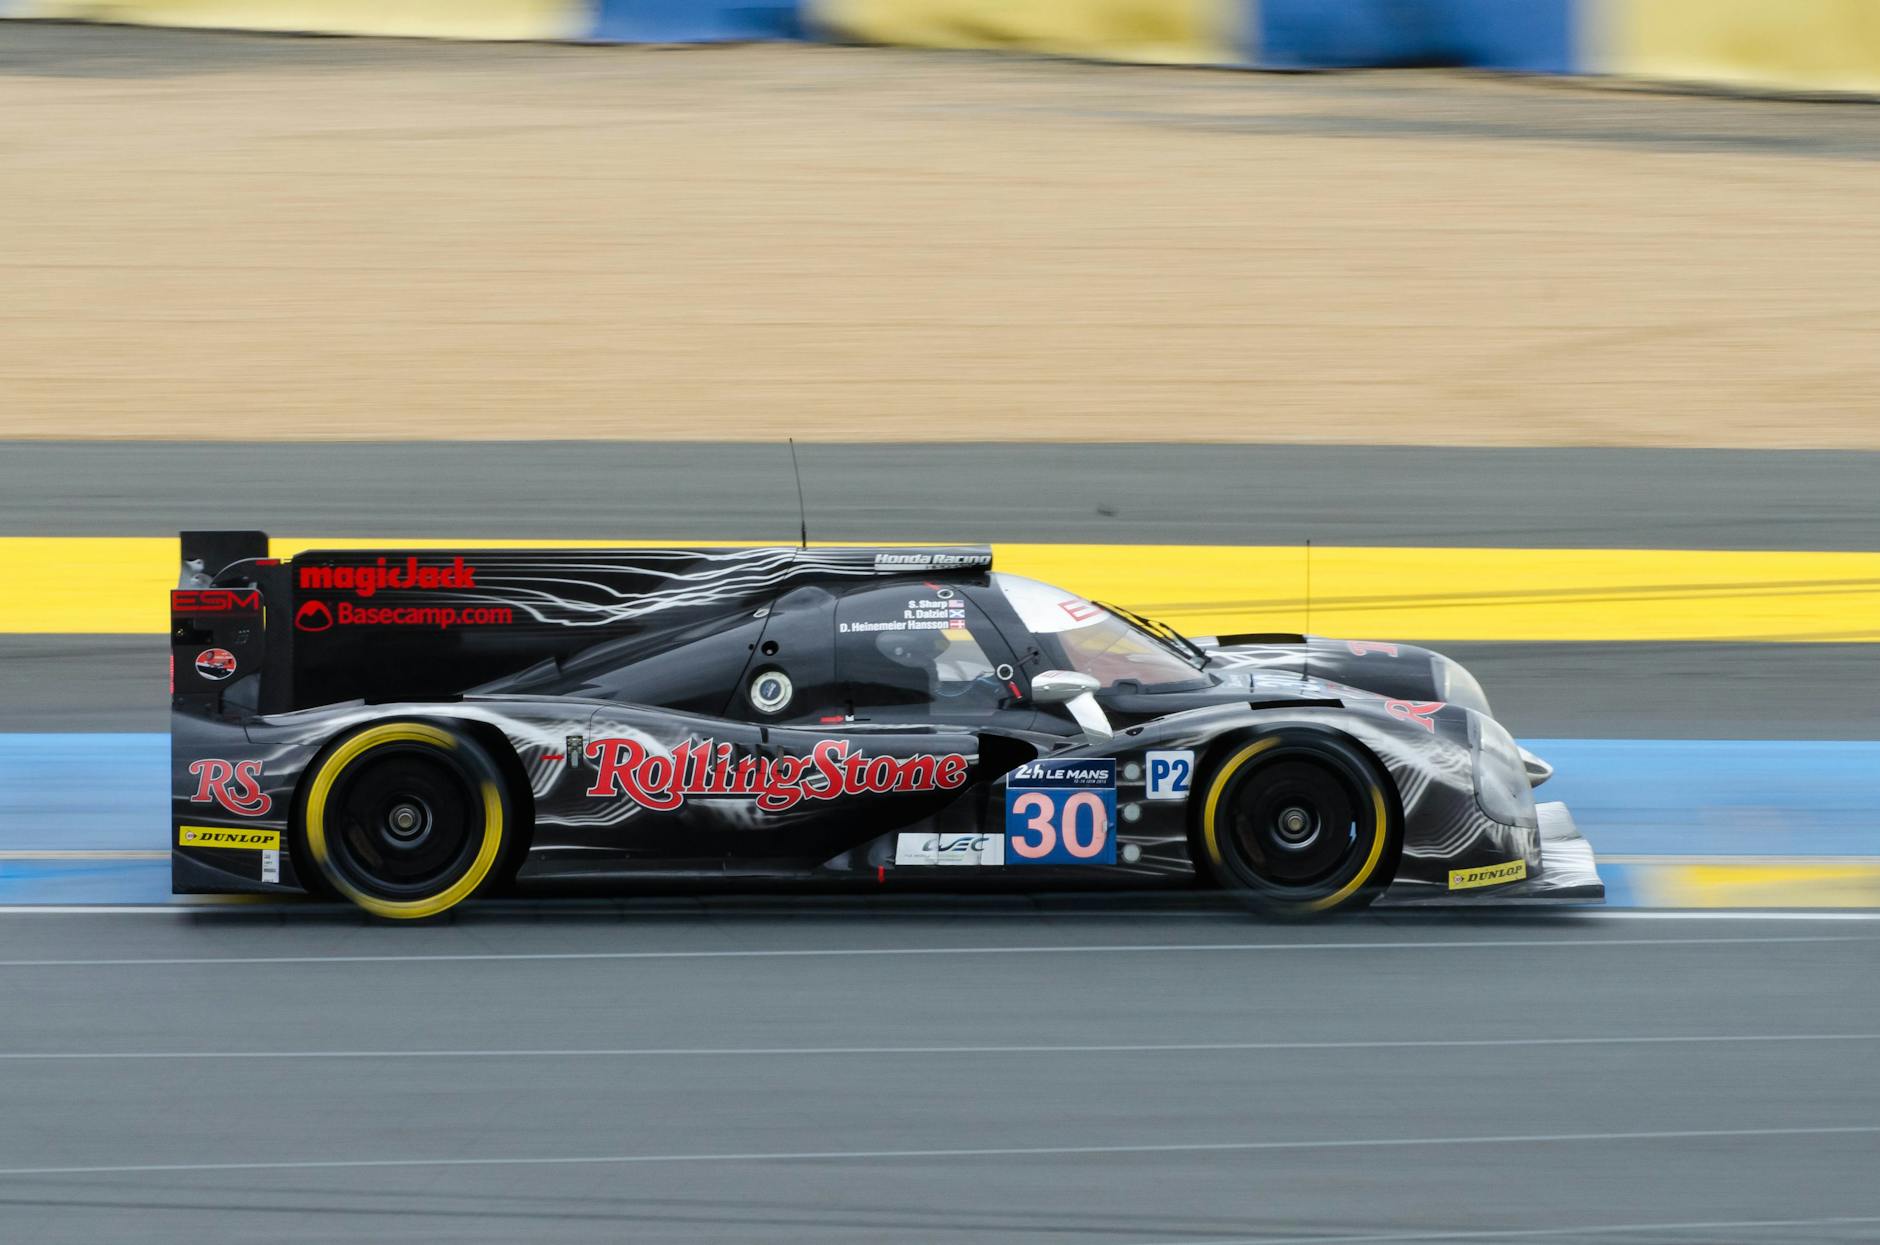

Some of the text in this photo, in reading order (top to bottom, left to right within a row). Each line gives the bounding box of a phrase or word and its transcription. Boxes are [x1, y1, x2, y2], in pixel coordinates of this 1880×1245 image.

[874, 554, 992, 566] Honda Racing
[300, 556, 476, 597] magicJack
[172, 590, 259, 611] ESM
[908, 600, 948, 609] S. Sharp
[338, 602, 513, 629] Basecamp.com
[904, 609, 948, 619] R. Dalziel
[839, 620, 949, 633] D. Heinemeier Hansson
[1046, 769, 1065, 779] LE
[1066, 769, 1109, 779] MANS
[1151, 759, 1189, 792] P2
[189, 759, 272, 816] RS
[1011, 792, 1108, 858] 30
[199, 833, 275, 844] DUNLOP
[1467, 865, 1523, 882] DUNLOP
